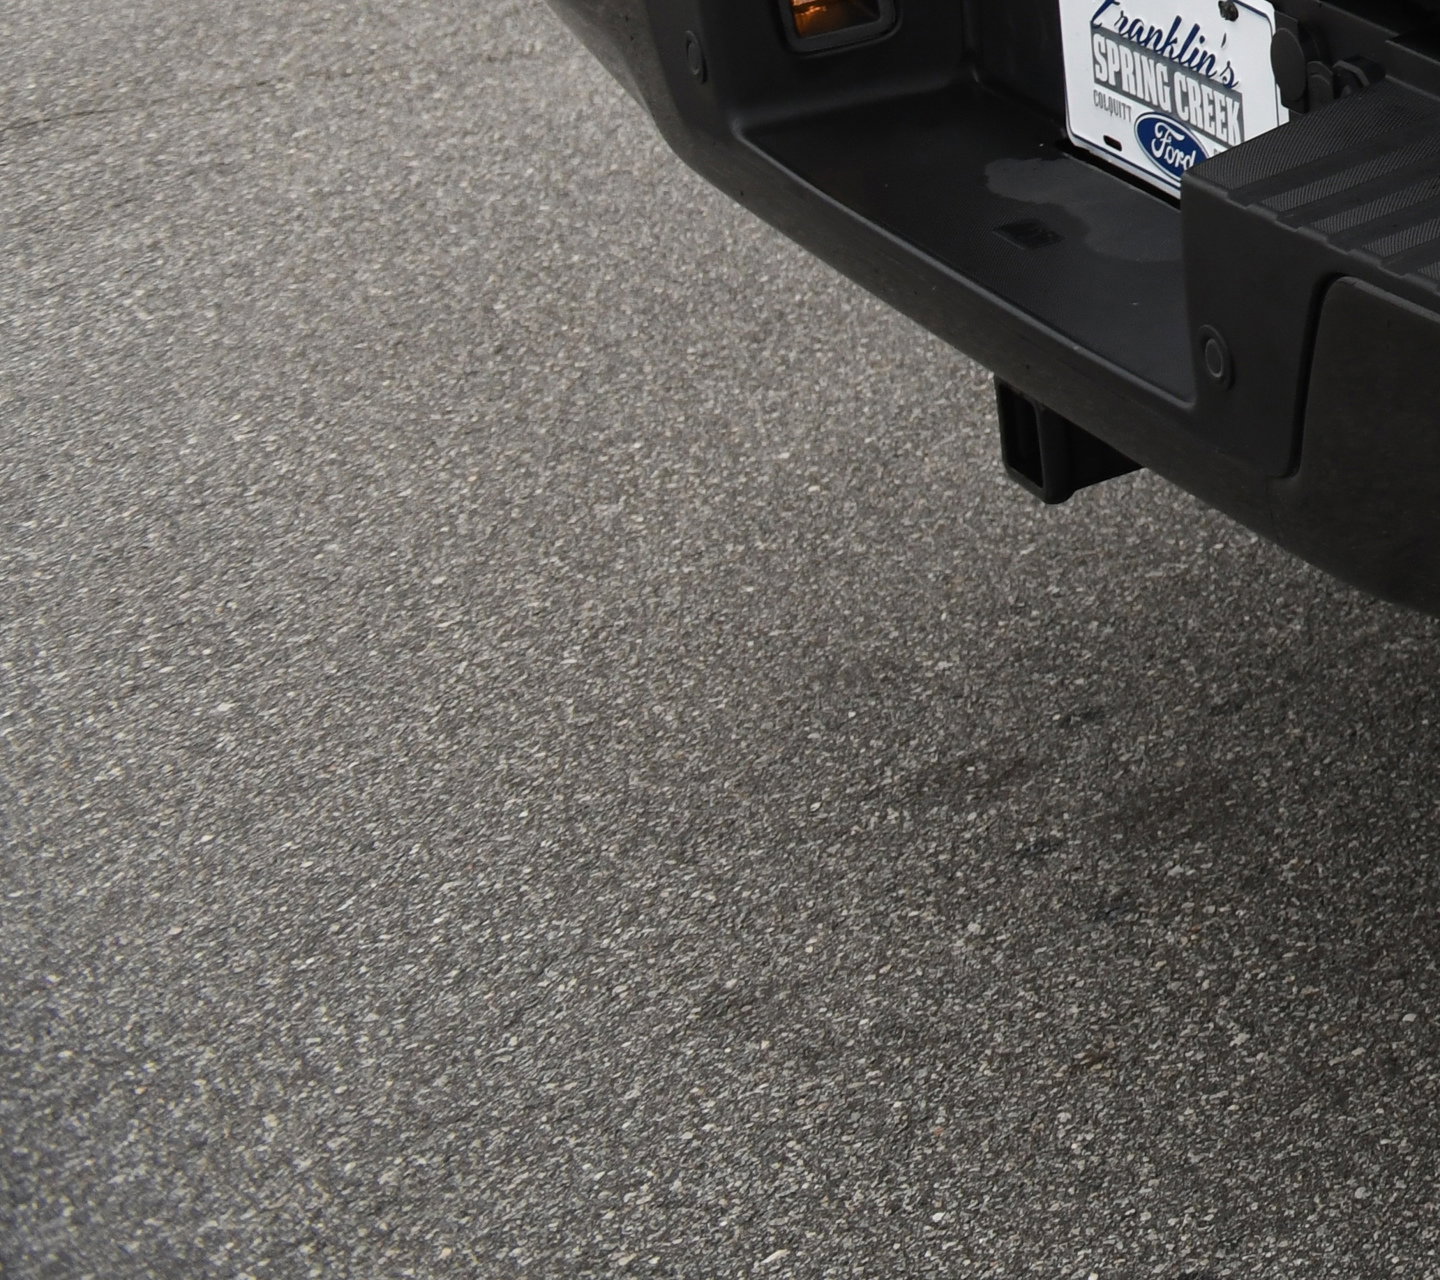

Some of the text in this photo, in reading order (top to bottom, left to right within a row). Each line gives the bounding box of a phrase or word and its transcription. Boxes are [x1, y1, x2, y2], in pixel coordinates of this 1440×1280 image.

[1092, 33, 1241, 147] SPRING CREEK
[1093, 89, 1133, 123] COLQUITT
[1151, 121, 1197, 171] Ford
